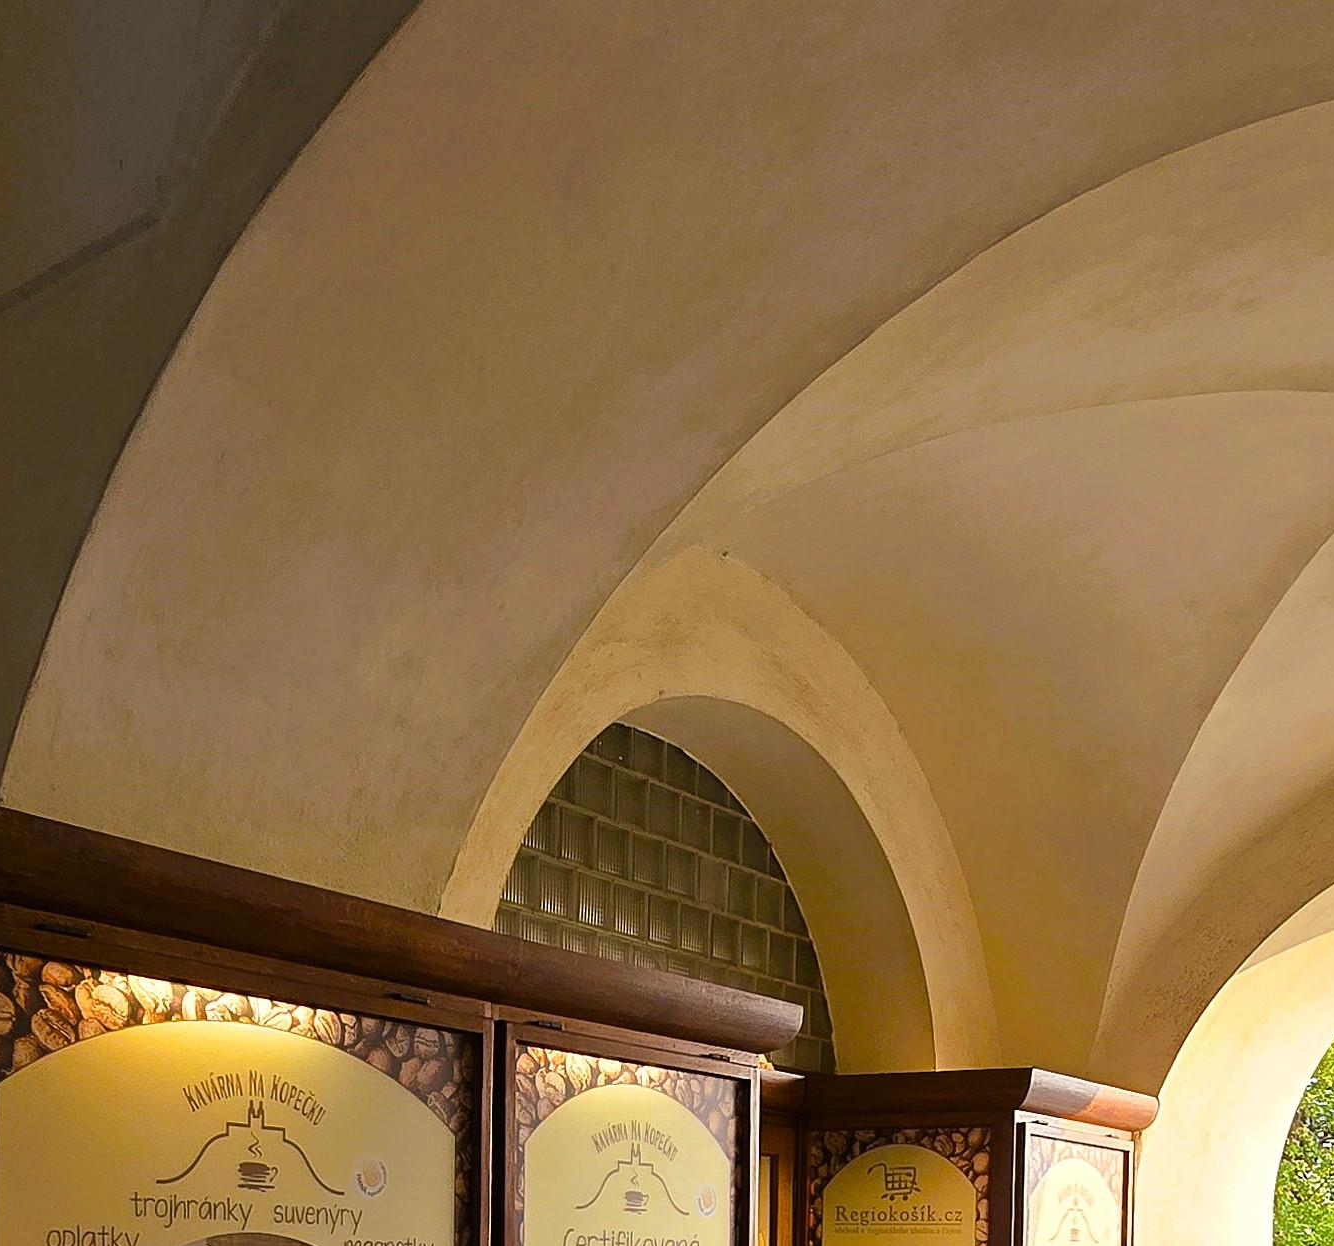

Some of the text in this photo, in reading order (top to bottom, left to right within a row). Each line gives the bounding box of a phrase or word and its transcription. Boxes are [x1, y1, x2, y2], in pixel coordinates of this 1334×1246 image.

[183, 1069, 326, 1126] KAVÁRNA NA KOPEČKU
[130, 1191, 362, 1235] trojhránky suvenýry
[835, 1205, 963, 1226] Regiokošík.cz
